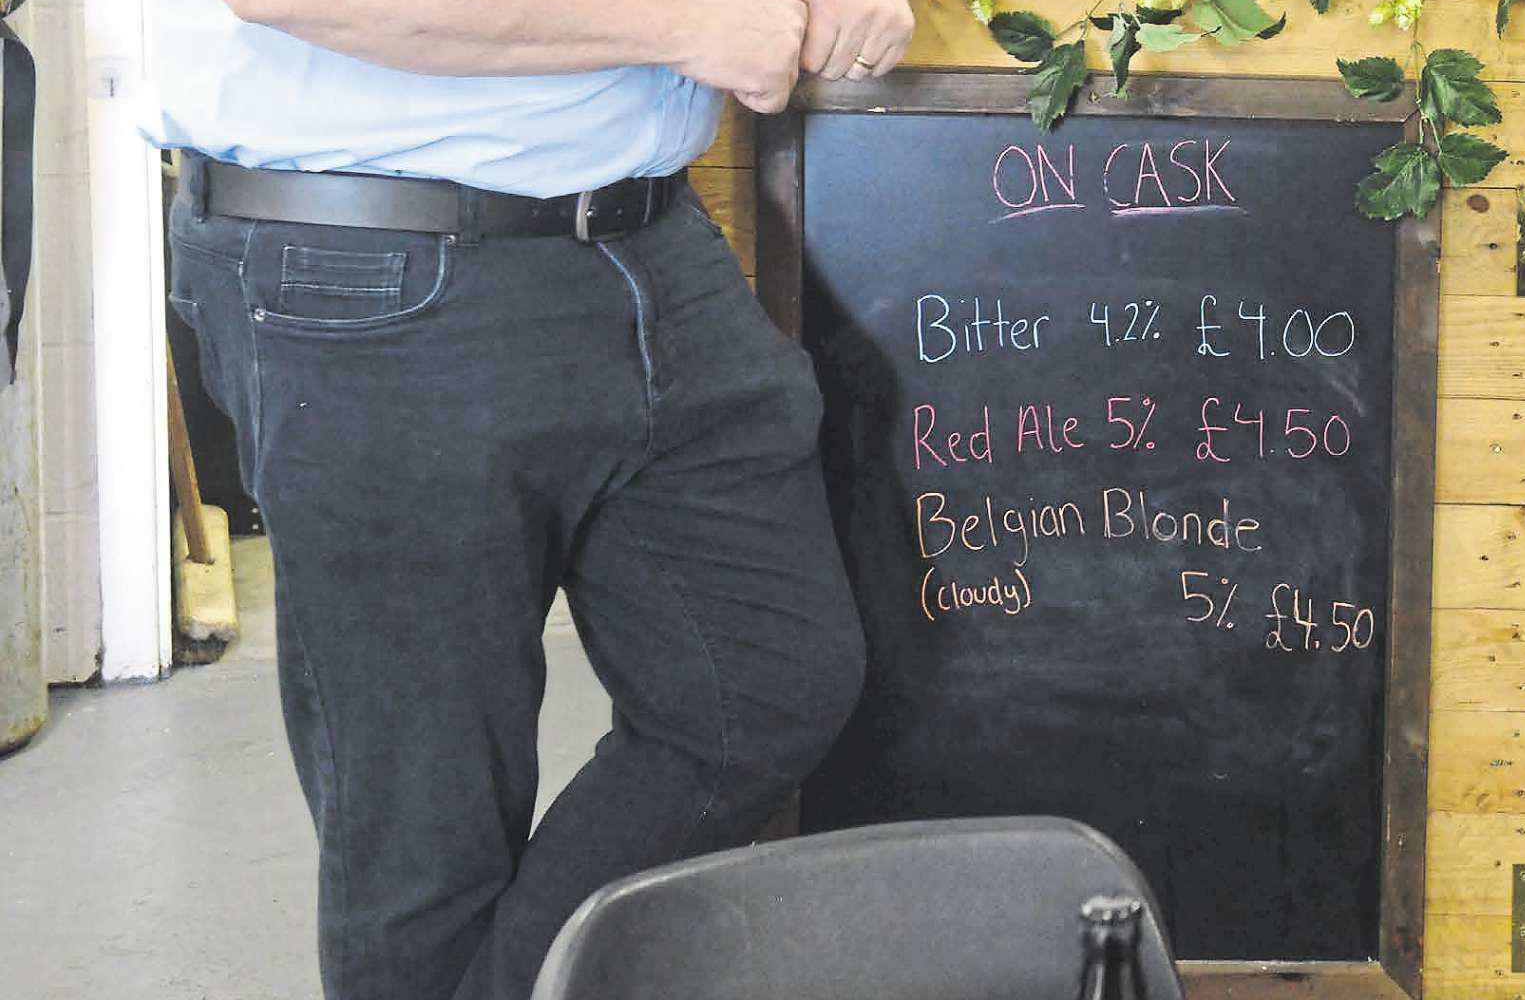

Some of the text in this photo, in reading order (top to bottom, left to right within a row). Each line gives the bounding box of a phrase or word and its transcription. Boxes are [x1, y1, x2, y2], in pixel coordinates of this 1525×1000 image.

[993, 140, 1236, 207] ON CASK
[916, 294, 1355, 362] Bitter 4.2% £4.00
[912, 397, 1350, 469] Red Ale 5% £4.50
[916, 487, 1263, 566] Belgian Blonde
[920, 566, 1376, 652] (cloudy) 5% £4.50
